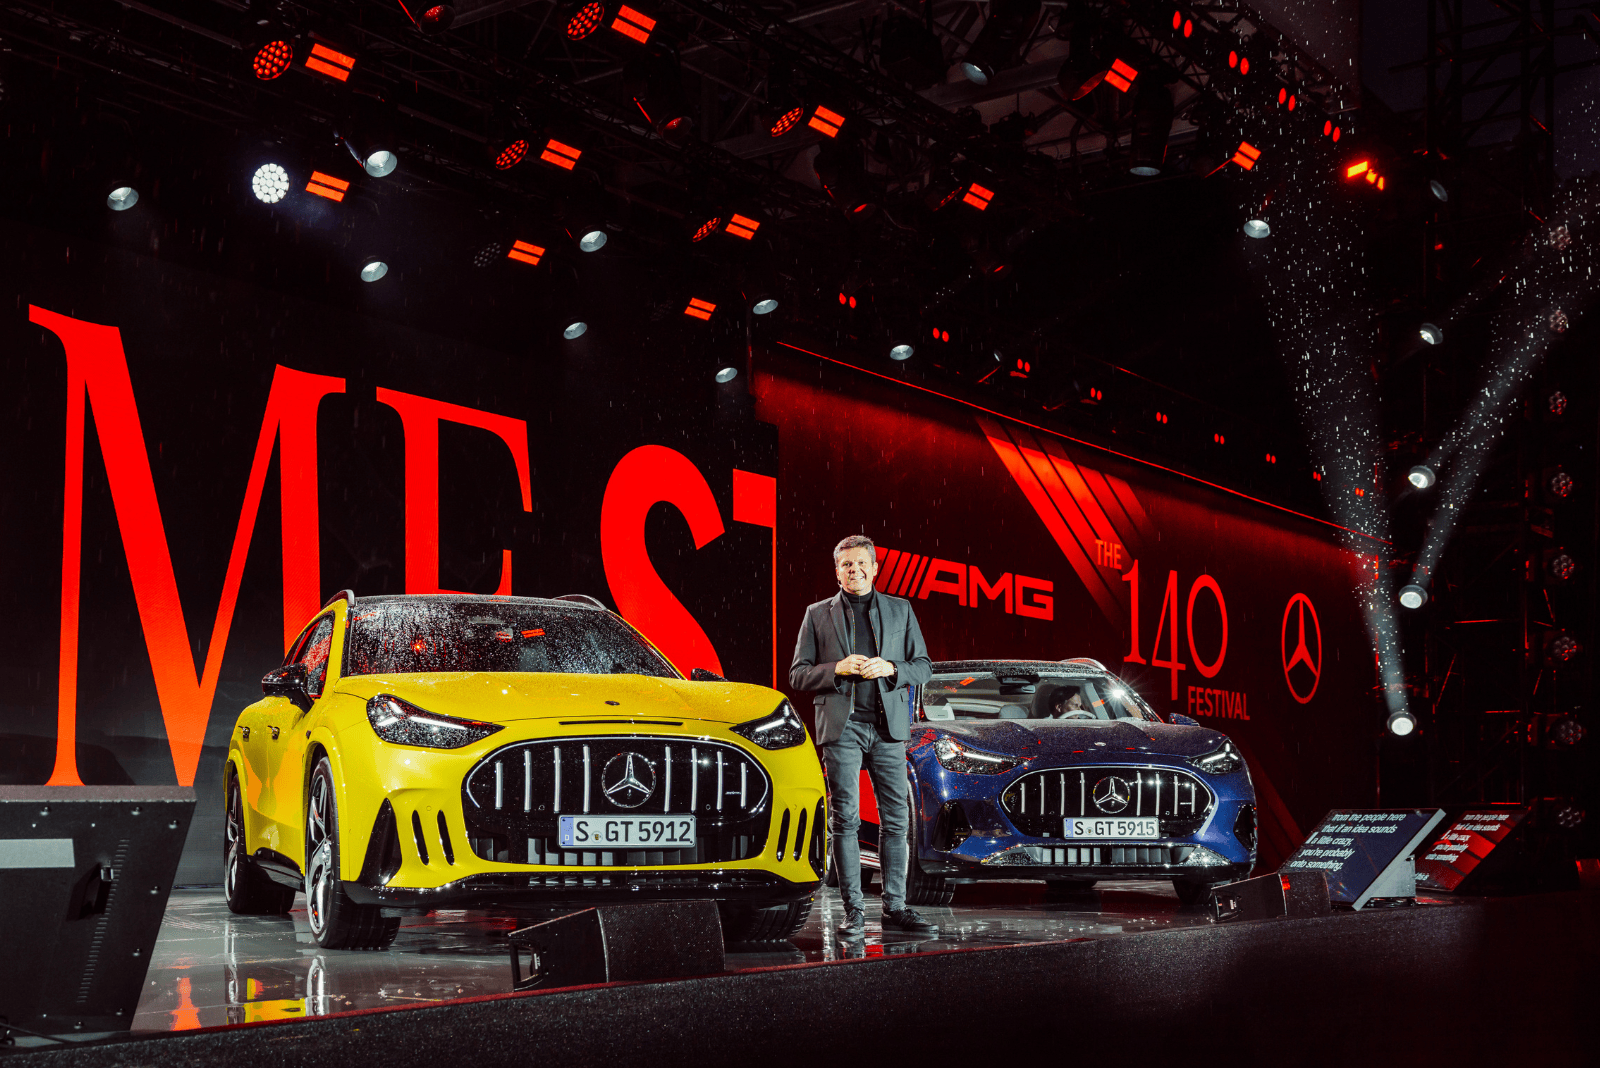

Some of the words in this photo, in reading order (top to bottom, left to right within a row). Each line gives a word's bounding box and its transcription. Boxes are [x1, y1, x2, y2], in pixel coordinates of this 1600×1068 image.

[1095, 538, 1122, 570] THE
[1121, 559, 1229, 701] 140
[1187, 685, 1251, 721] FESTIVAL
[1359, 813, 1388, 823] people
[1386, 813, 1407, 821] here
[575, 821, 589, 841] S
[605, 821, 633, 842] GT
[638, 821, 691, 842] 5912
[1074, 821, 1084, 835] S
[1094, 821, 1114, 836] GT
[1117, 821, 1155, 836] 5915
[1321, 824, 1338, 833] that
[1352, 824, 1370, 833] idea
[1368, 824, 1398, 833] sounds
[1317, 836, 1333, 844] little
[1331, 837, 1354, 847] crazy,
[1298, 848, 1323, 858] you're
[1320, 848, 1356, 860] probably
[1290, 860, 1307, 868] onto
[1306, 860, 1344, 871] something.
